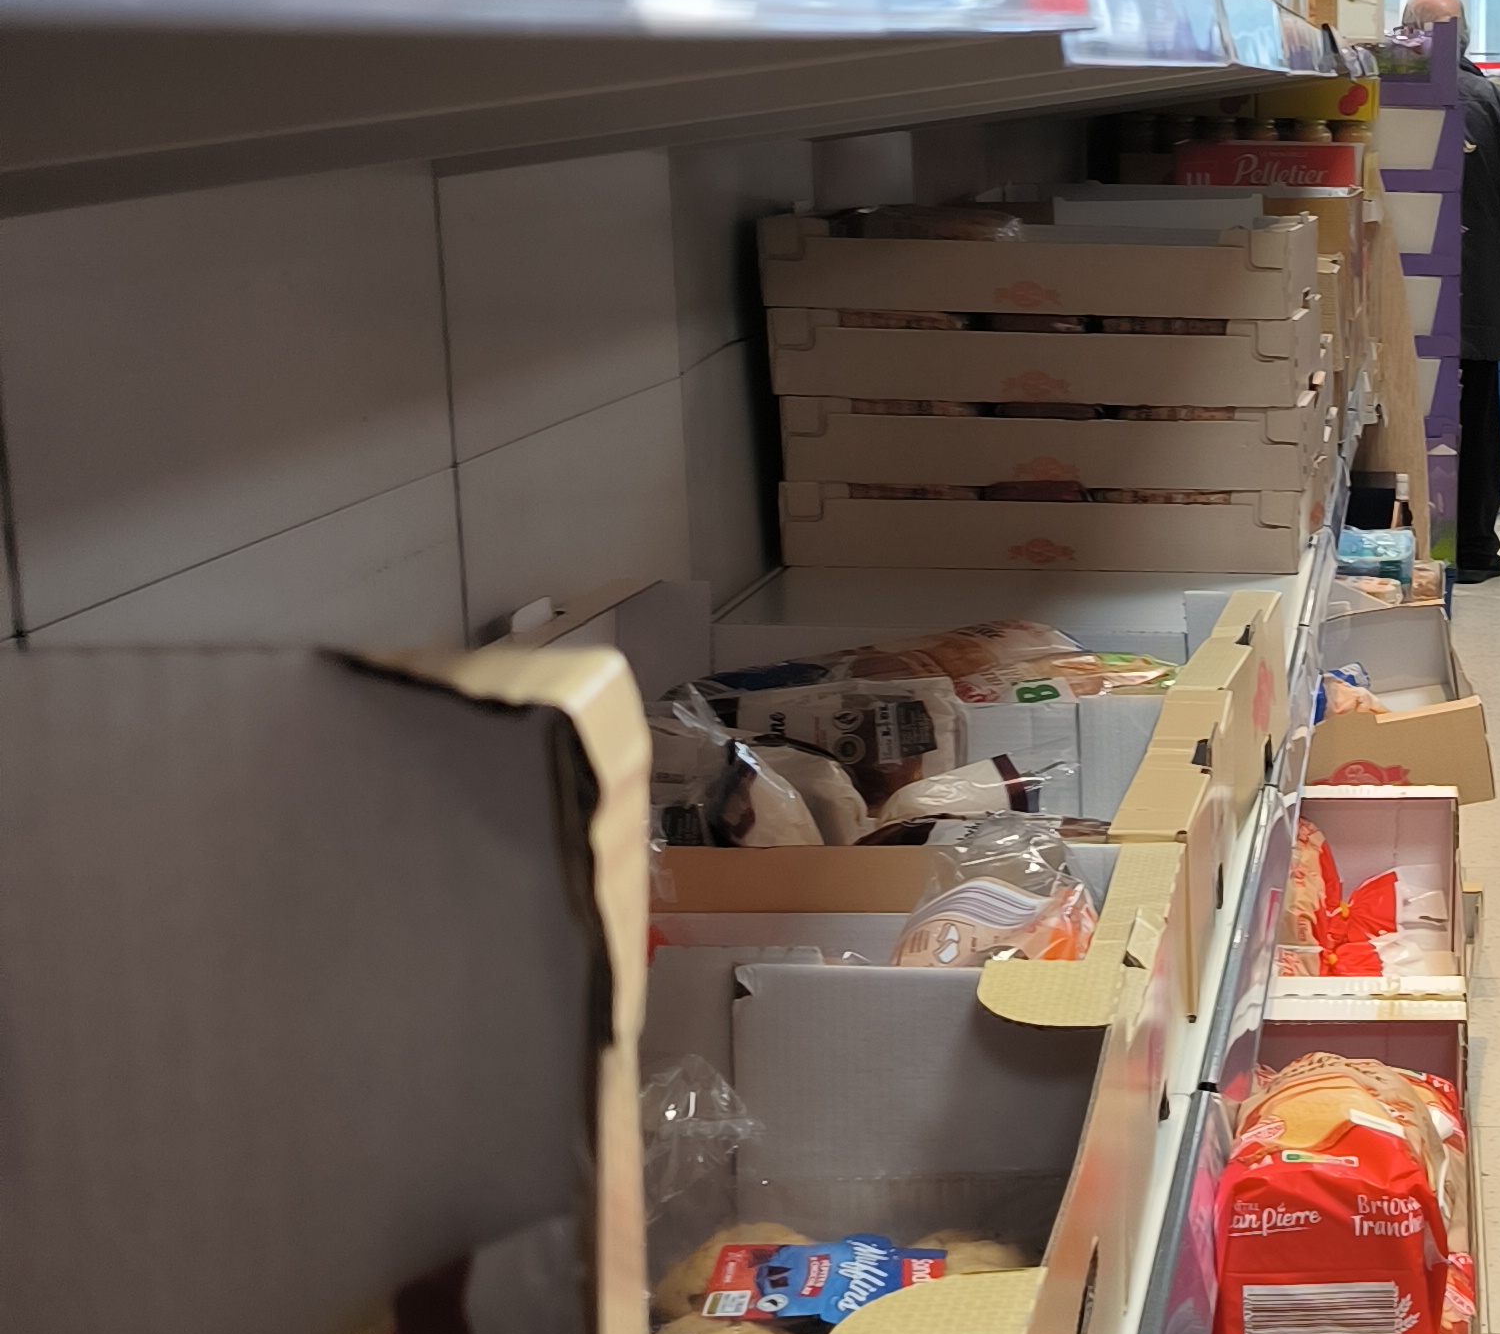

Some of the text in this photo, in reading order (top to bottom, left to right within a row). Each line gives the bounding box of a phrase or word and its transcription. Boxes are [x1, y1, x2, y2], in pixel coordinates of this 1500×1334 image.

[1233, 153, 1328, 185] Pelletier
[1261, 1202, 1323, 1237] Pierre
[838, 1240, 889, 1313] Muffins
